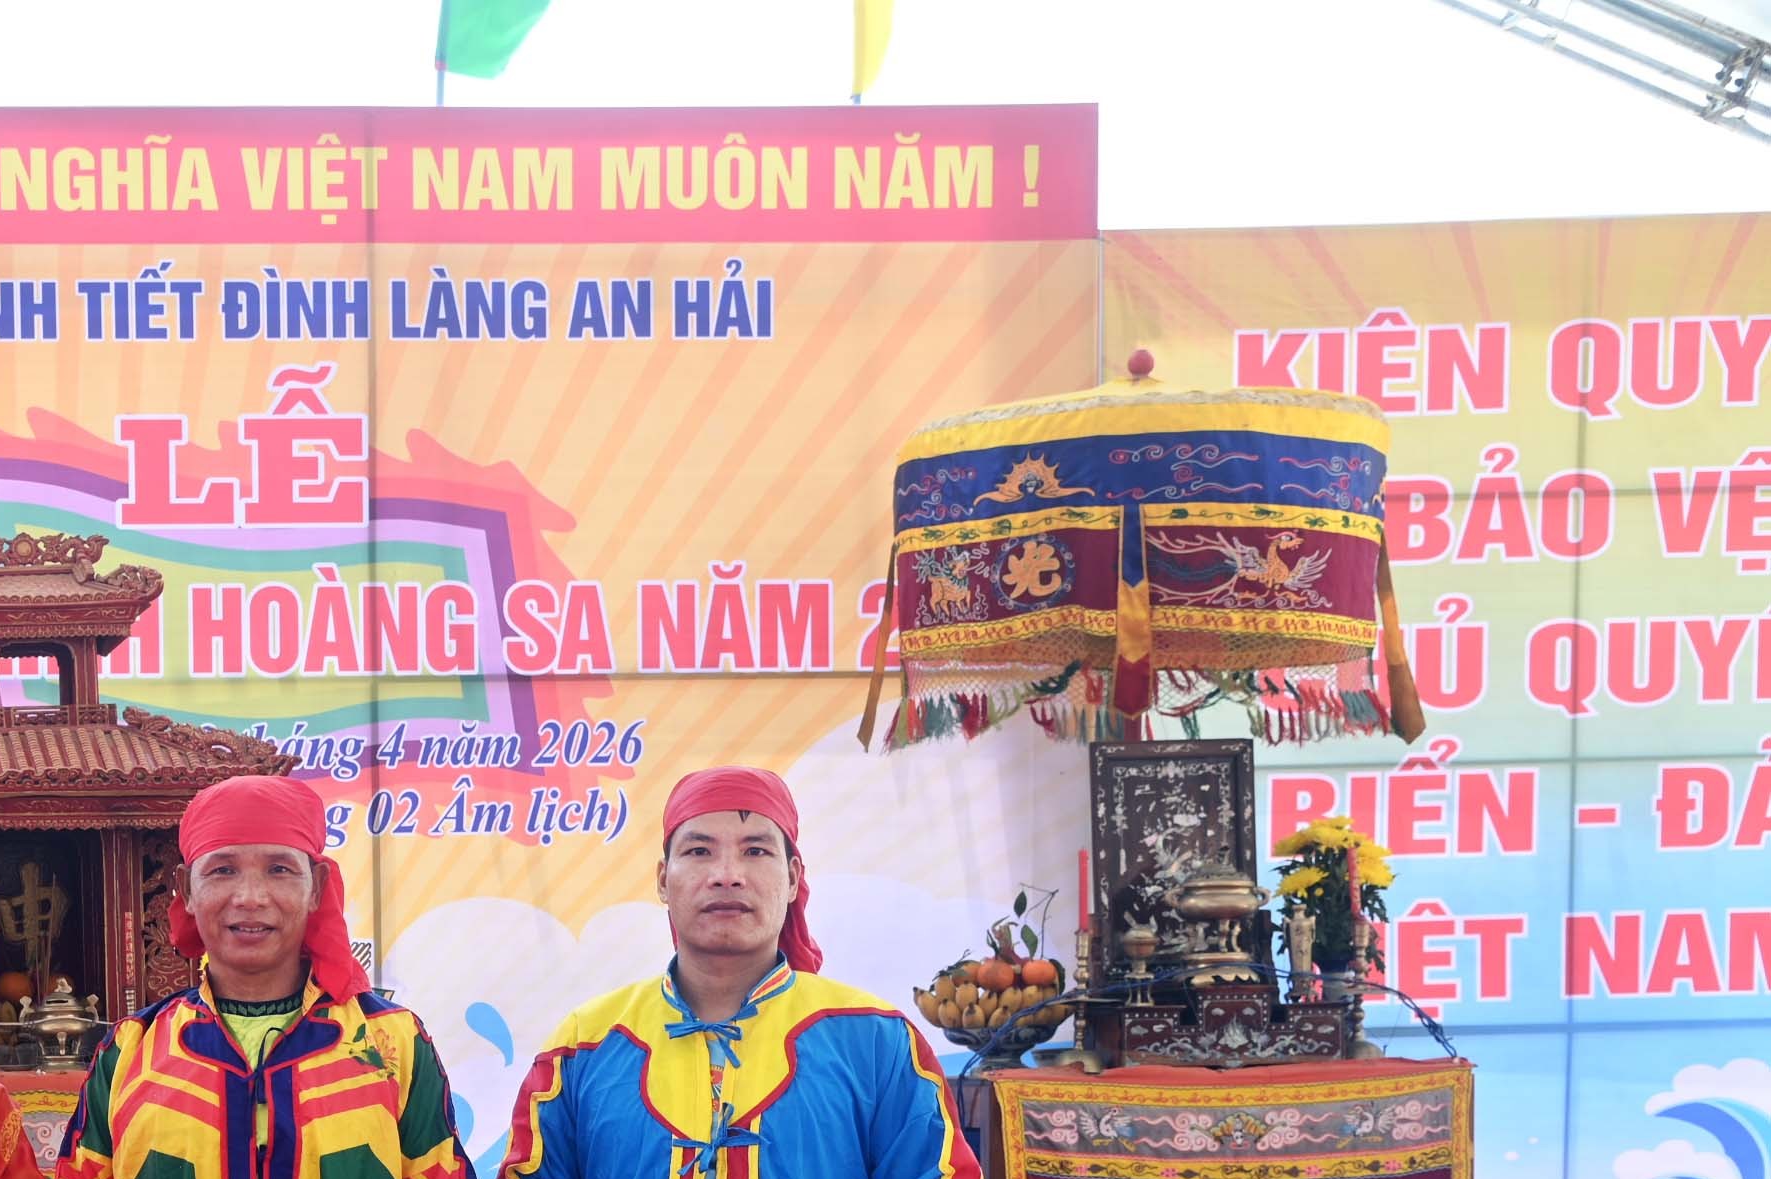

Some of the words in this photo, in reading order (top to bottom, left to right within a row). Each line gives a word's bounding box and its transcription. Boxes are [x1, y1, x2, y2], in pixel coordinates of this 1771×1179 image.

[239, 133, 389, 226] VIỆT
[411, 145, 574, 212] NAM
[599, 132, 809, 212] MUÔN
[833, 131, 994, 211] NĂM
[1022, 143, 1040, 209] !
[77, 261, 204, 341] TIẾT
[221, 266, 371, 341] ĐÌNH
[390, 267, 548, 341] LÀNG
[567, 280, 654, 340] AN
[673, 258, 774, 340] HẢI
[1234, 310, 1510, 414] KIÊN
[116, 361, 369, 529] LỄ
[1386, 443, 1612, 562] BẢO
[190, 565, 480, 678] HOÀNG
[504, 578, 613, 676] SA
[636, 560, 830, 674] NĂM
[1526, 617, 1771, 716] QUY
[376, 721, 409, 769] 4
[421, 723, 521, 768] năm
[531, 719, 646, 768] 2026
[367, 789, 421, 836] 02
[430, 776, 520, 834] Âm
[526, 785, 629, 847] lịch)
[1268, 739, 1536, 858] BIỂN
